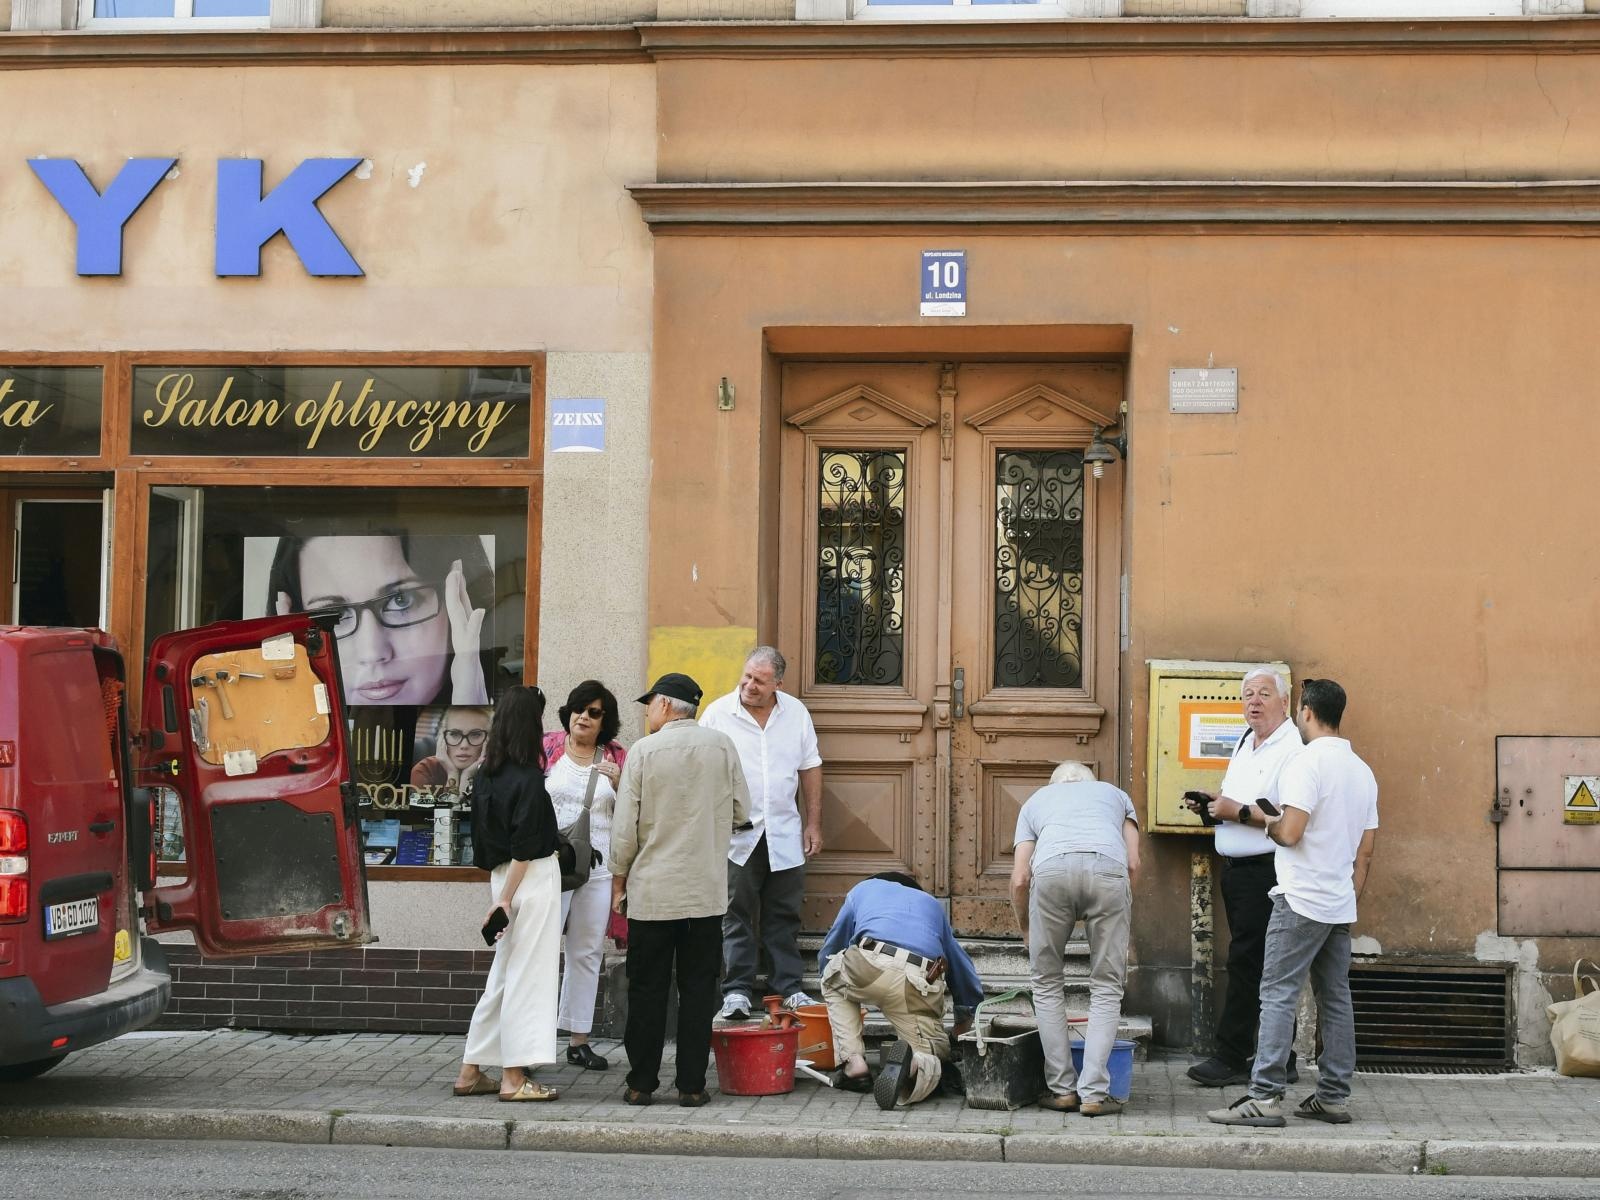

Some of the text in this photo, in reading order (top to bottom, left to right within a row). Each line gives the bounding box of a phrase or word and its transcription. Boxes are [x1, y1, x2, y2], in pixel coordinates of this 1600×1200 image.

[927, 261, 959, 288] 10
[143, 373, 516, 452] Salon optyczny
[552, 412, 602, 426] ZEISS
[48, 831, 79, 843] EXPERT
[52, 908, 61, 930] VB
[67, 904, 78, 926] GD
[79, 901, 96, 924] 1027
